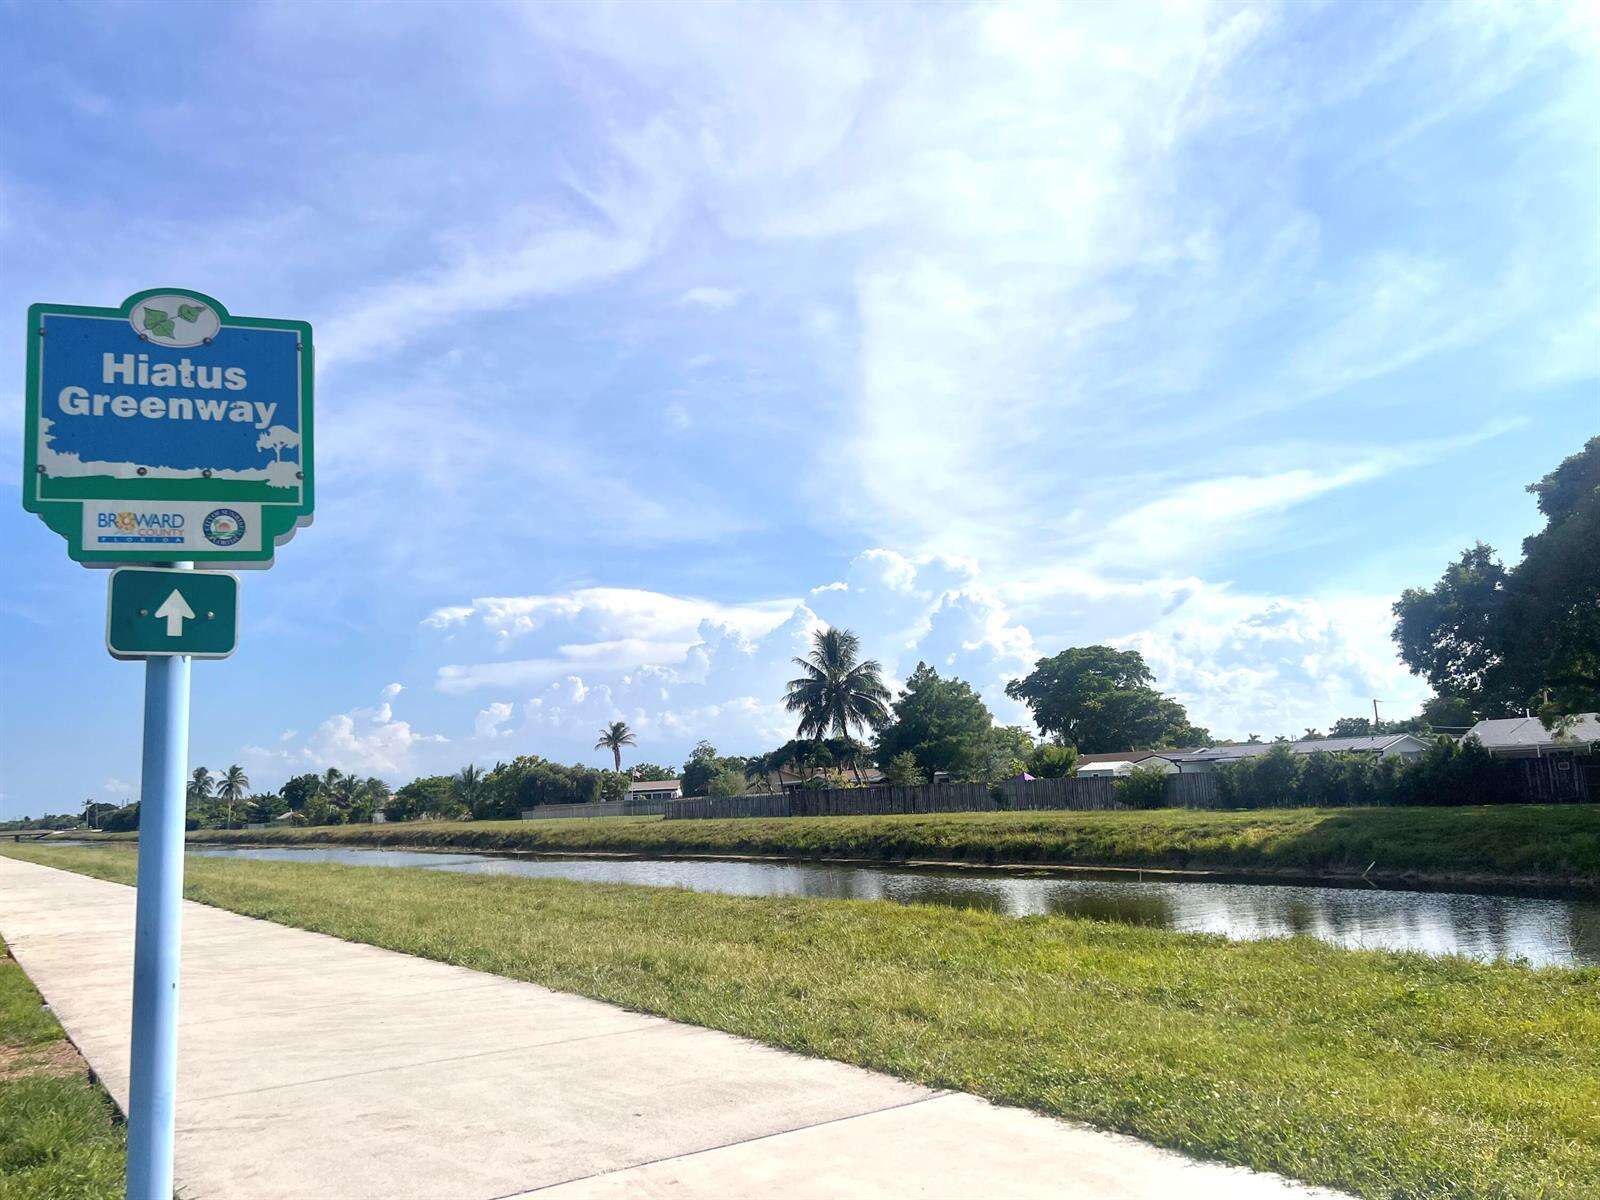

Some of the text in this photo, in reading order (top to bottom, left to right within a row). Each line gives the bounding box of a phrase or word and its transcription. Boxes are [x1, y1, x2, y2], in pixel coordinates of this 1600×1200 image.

[103, 352, 248, 391] Hiatus
[58, 386, 278, 430] Greenway
[97, 512, 185, 530] BROWARD
[138, 528, 184, 537] COUNTY
